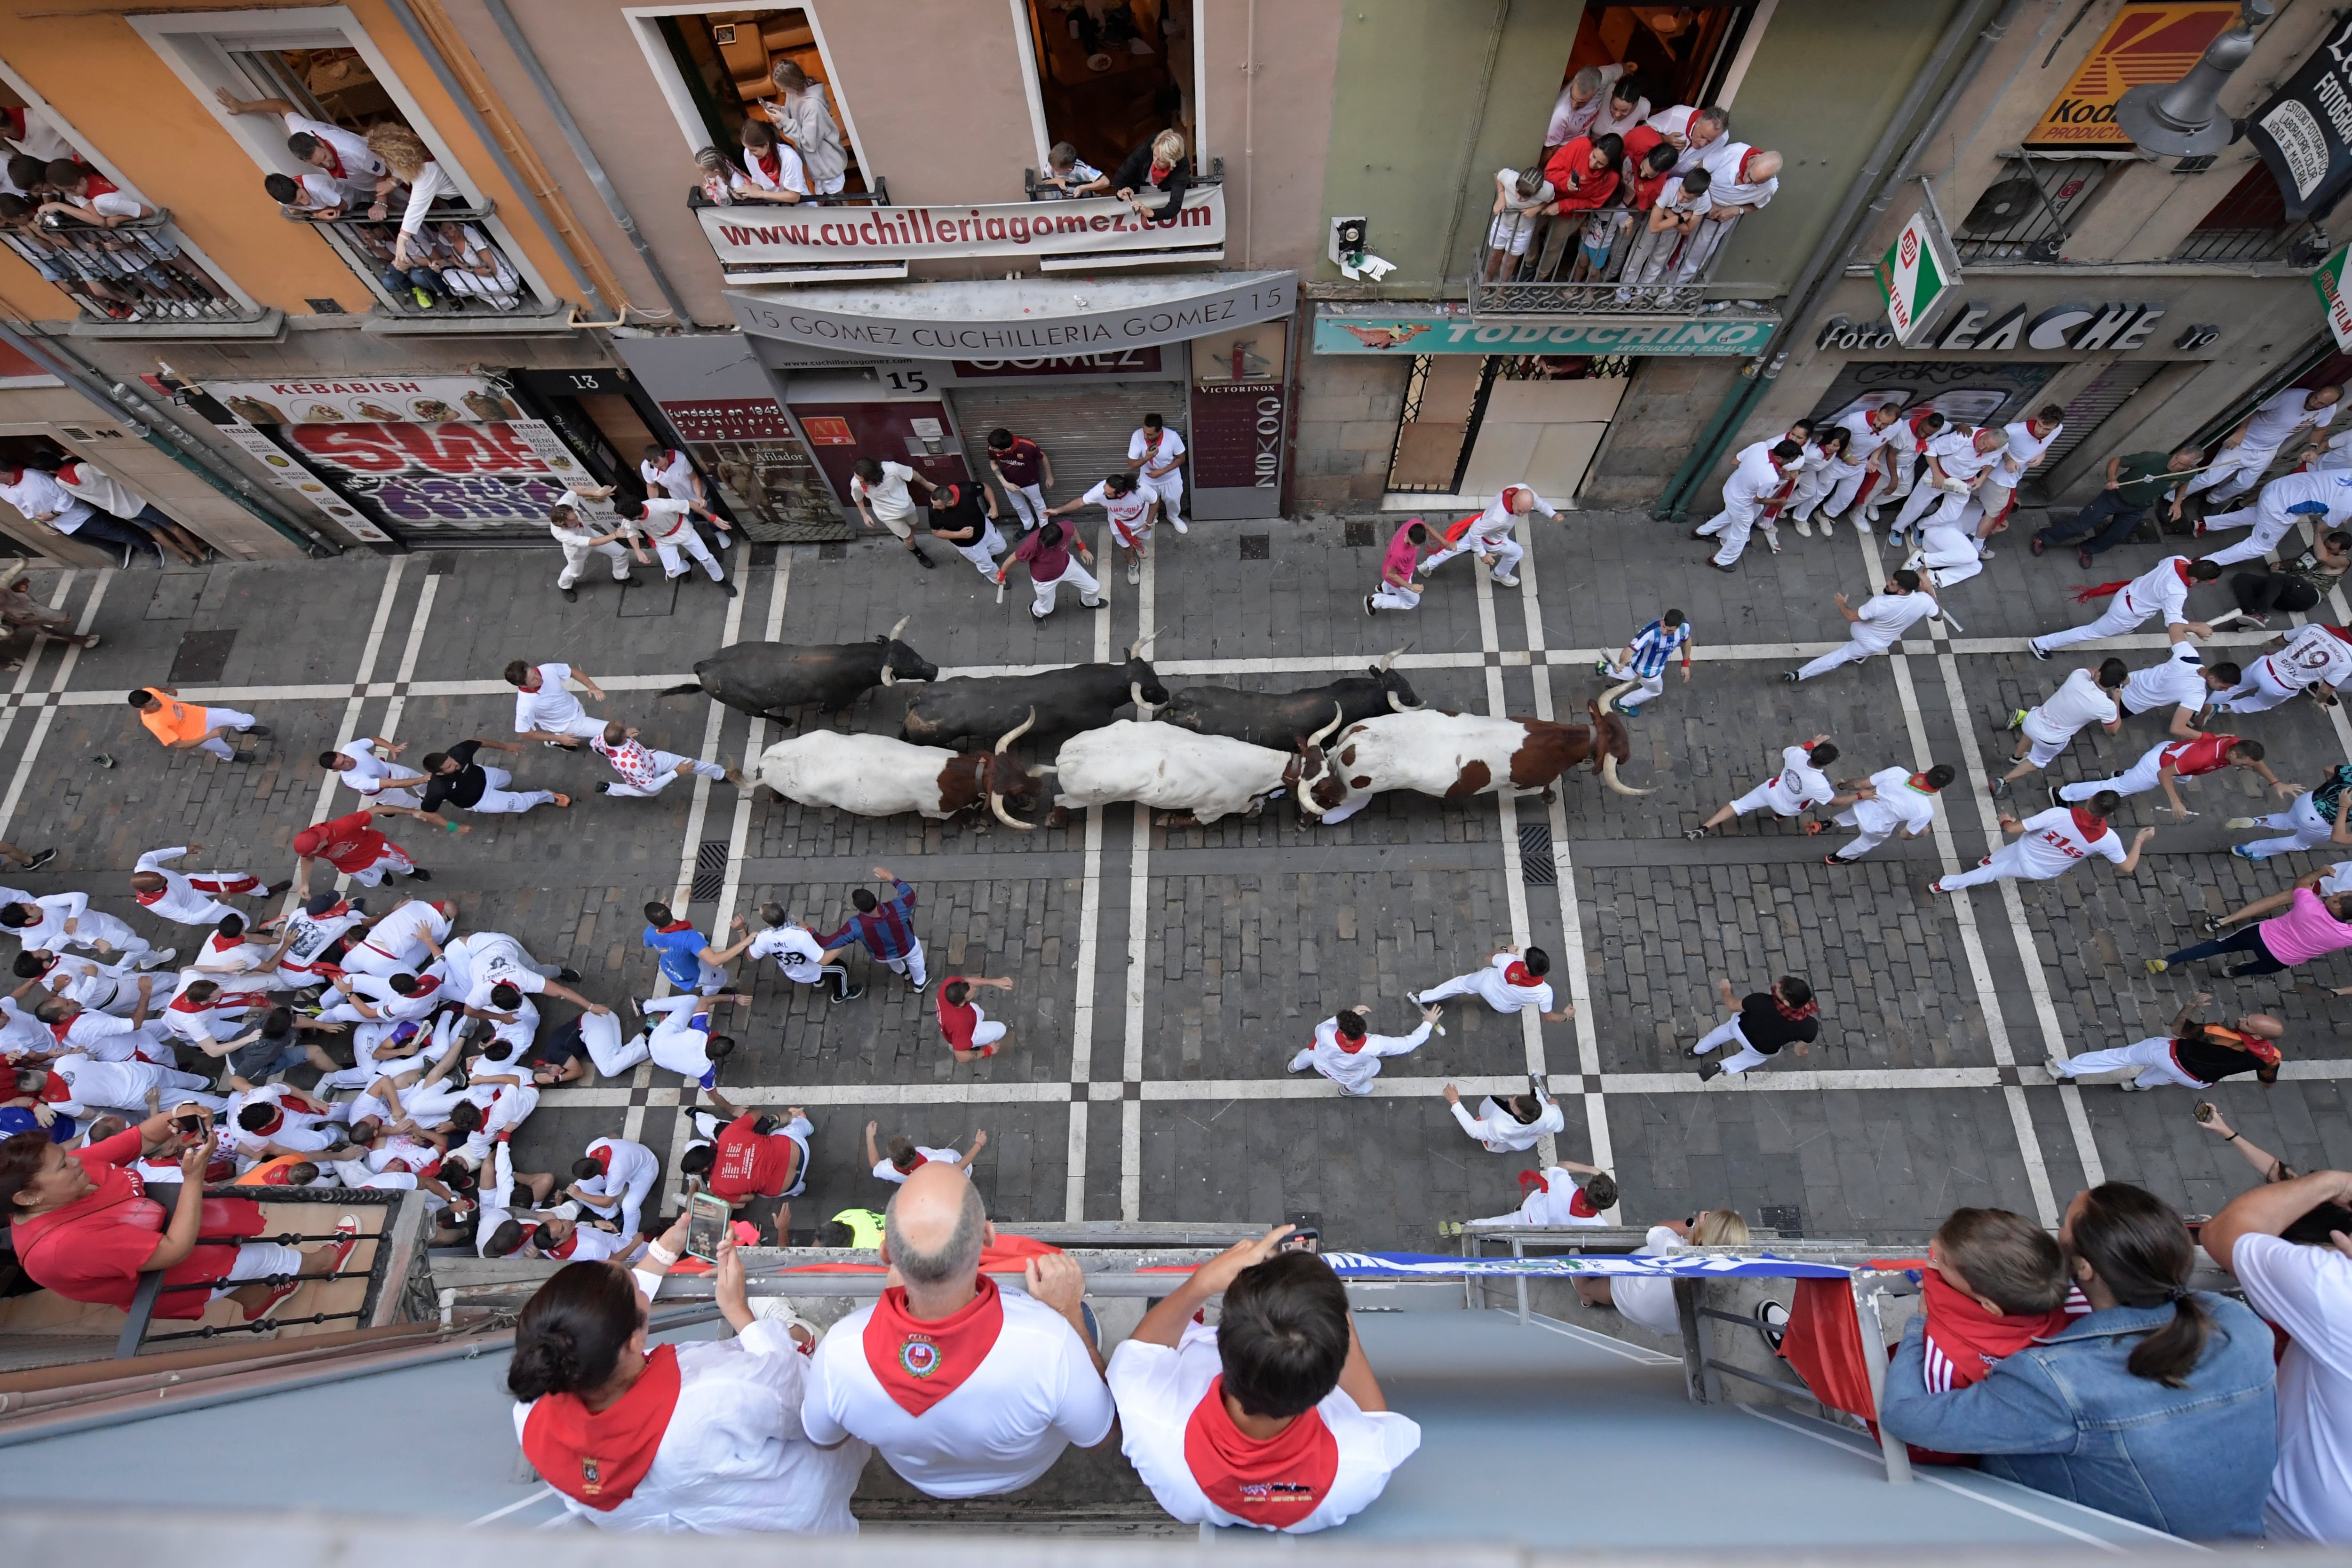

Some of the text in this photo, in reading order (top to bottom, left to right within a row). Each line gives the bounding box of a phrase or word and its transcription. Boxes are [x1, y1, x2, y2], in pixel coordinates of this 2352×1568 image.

[2049, 99, 2120, 123] Kod
[2042, 127, 2128, 139] PRODUCTO
[2285, 100, 2329, 175] ESTUDIO FOTOGRAFICO
[2268, 119, 2309, 192] VENTA DE MATERIAL
[2279, 113, 2318, 182] LABORATORIO COLOR
[719, 206, 1211, 246] www.cuchilleriagomez.com
[1879, 261, 1908, 329] FUJIFILM
[2319, 269, 2352, 336] FUJIFILM
[745, 287, 1281, 349] 15 GOMEZ CUCHILLERIA GOMEZ 15
[1446, 324, 1759, 344] TODOCHINO
[1819, 325, 1894, 350] foto
[2179, 330, 2219, 351] 19
[783, 358, 912, 367] www.cuchilleriagomez.com
[270, 382, 422, 395] KEBABISH
[569, 375, 599, 389] 13
[886, 371, 929, 393] 15
[815, 421, 843, 435] AT
[1255, 396, 1281, 488] GOMEZ
[756, 452, 803, 461] Afilador
[2291, 640, 2330, 669] 19
